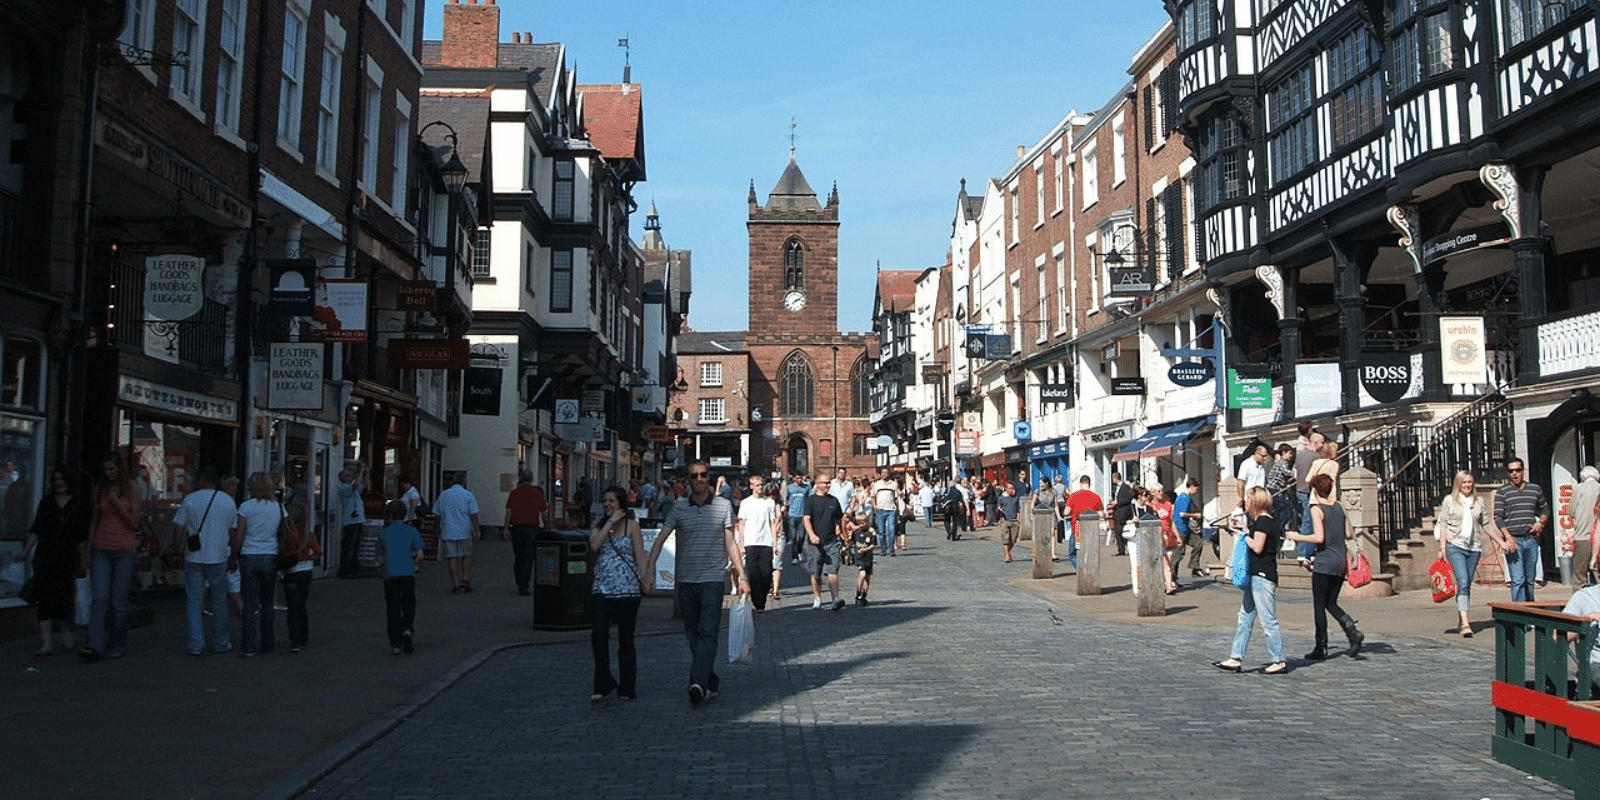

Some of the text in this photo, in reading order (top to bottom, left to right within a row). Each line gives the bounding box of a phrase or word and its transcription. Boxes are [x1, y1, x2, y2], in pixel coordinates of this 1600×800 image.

[1456, 233, 1477, 245] Centre
[153, 260, 197, 271] LEATHER
[159, 270, 191, 280] GOODS
[1120, 272, 1143, 285] AR
[150, 282, 198, 291] HANDBAGS
[399, 285, 435, 297] Liberty
[153, 294, 192, 304] LUGGAGE
[1447, 324, 1478, 335] urchin
[273, 348, 318, 360] LEATHER
[409, 350, 448, 358] NICOLAS
[279, 358, 312, 368] GOODS
[272, 370, 320, 380] HANDBAGS
[1364, 365, 1408, 380] BOSS
[276, 381, 315, 391] LUGGAGE
[469, 385, 493, 396] South
[1042, 388, 1069, 398] lakeland
